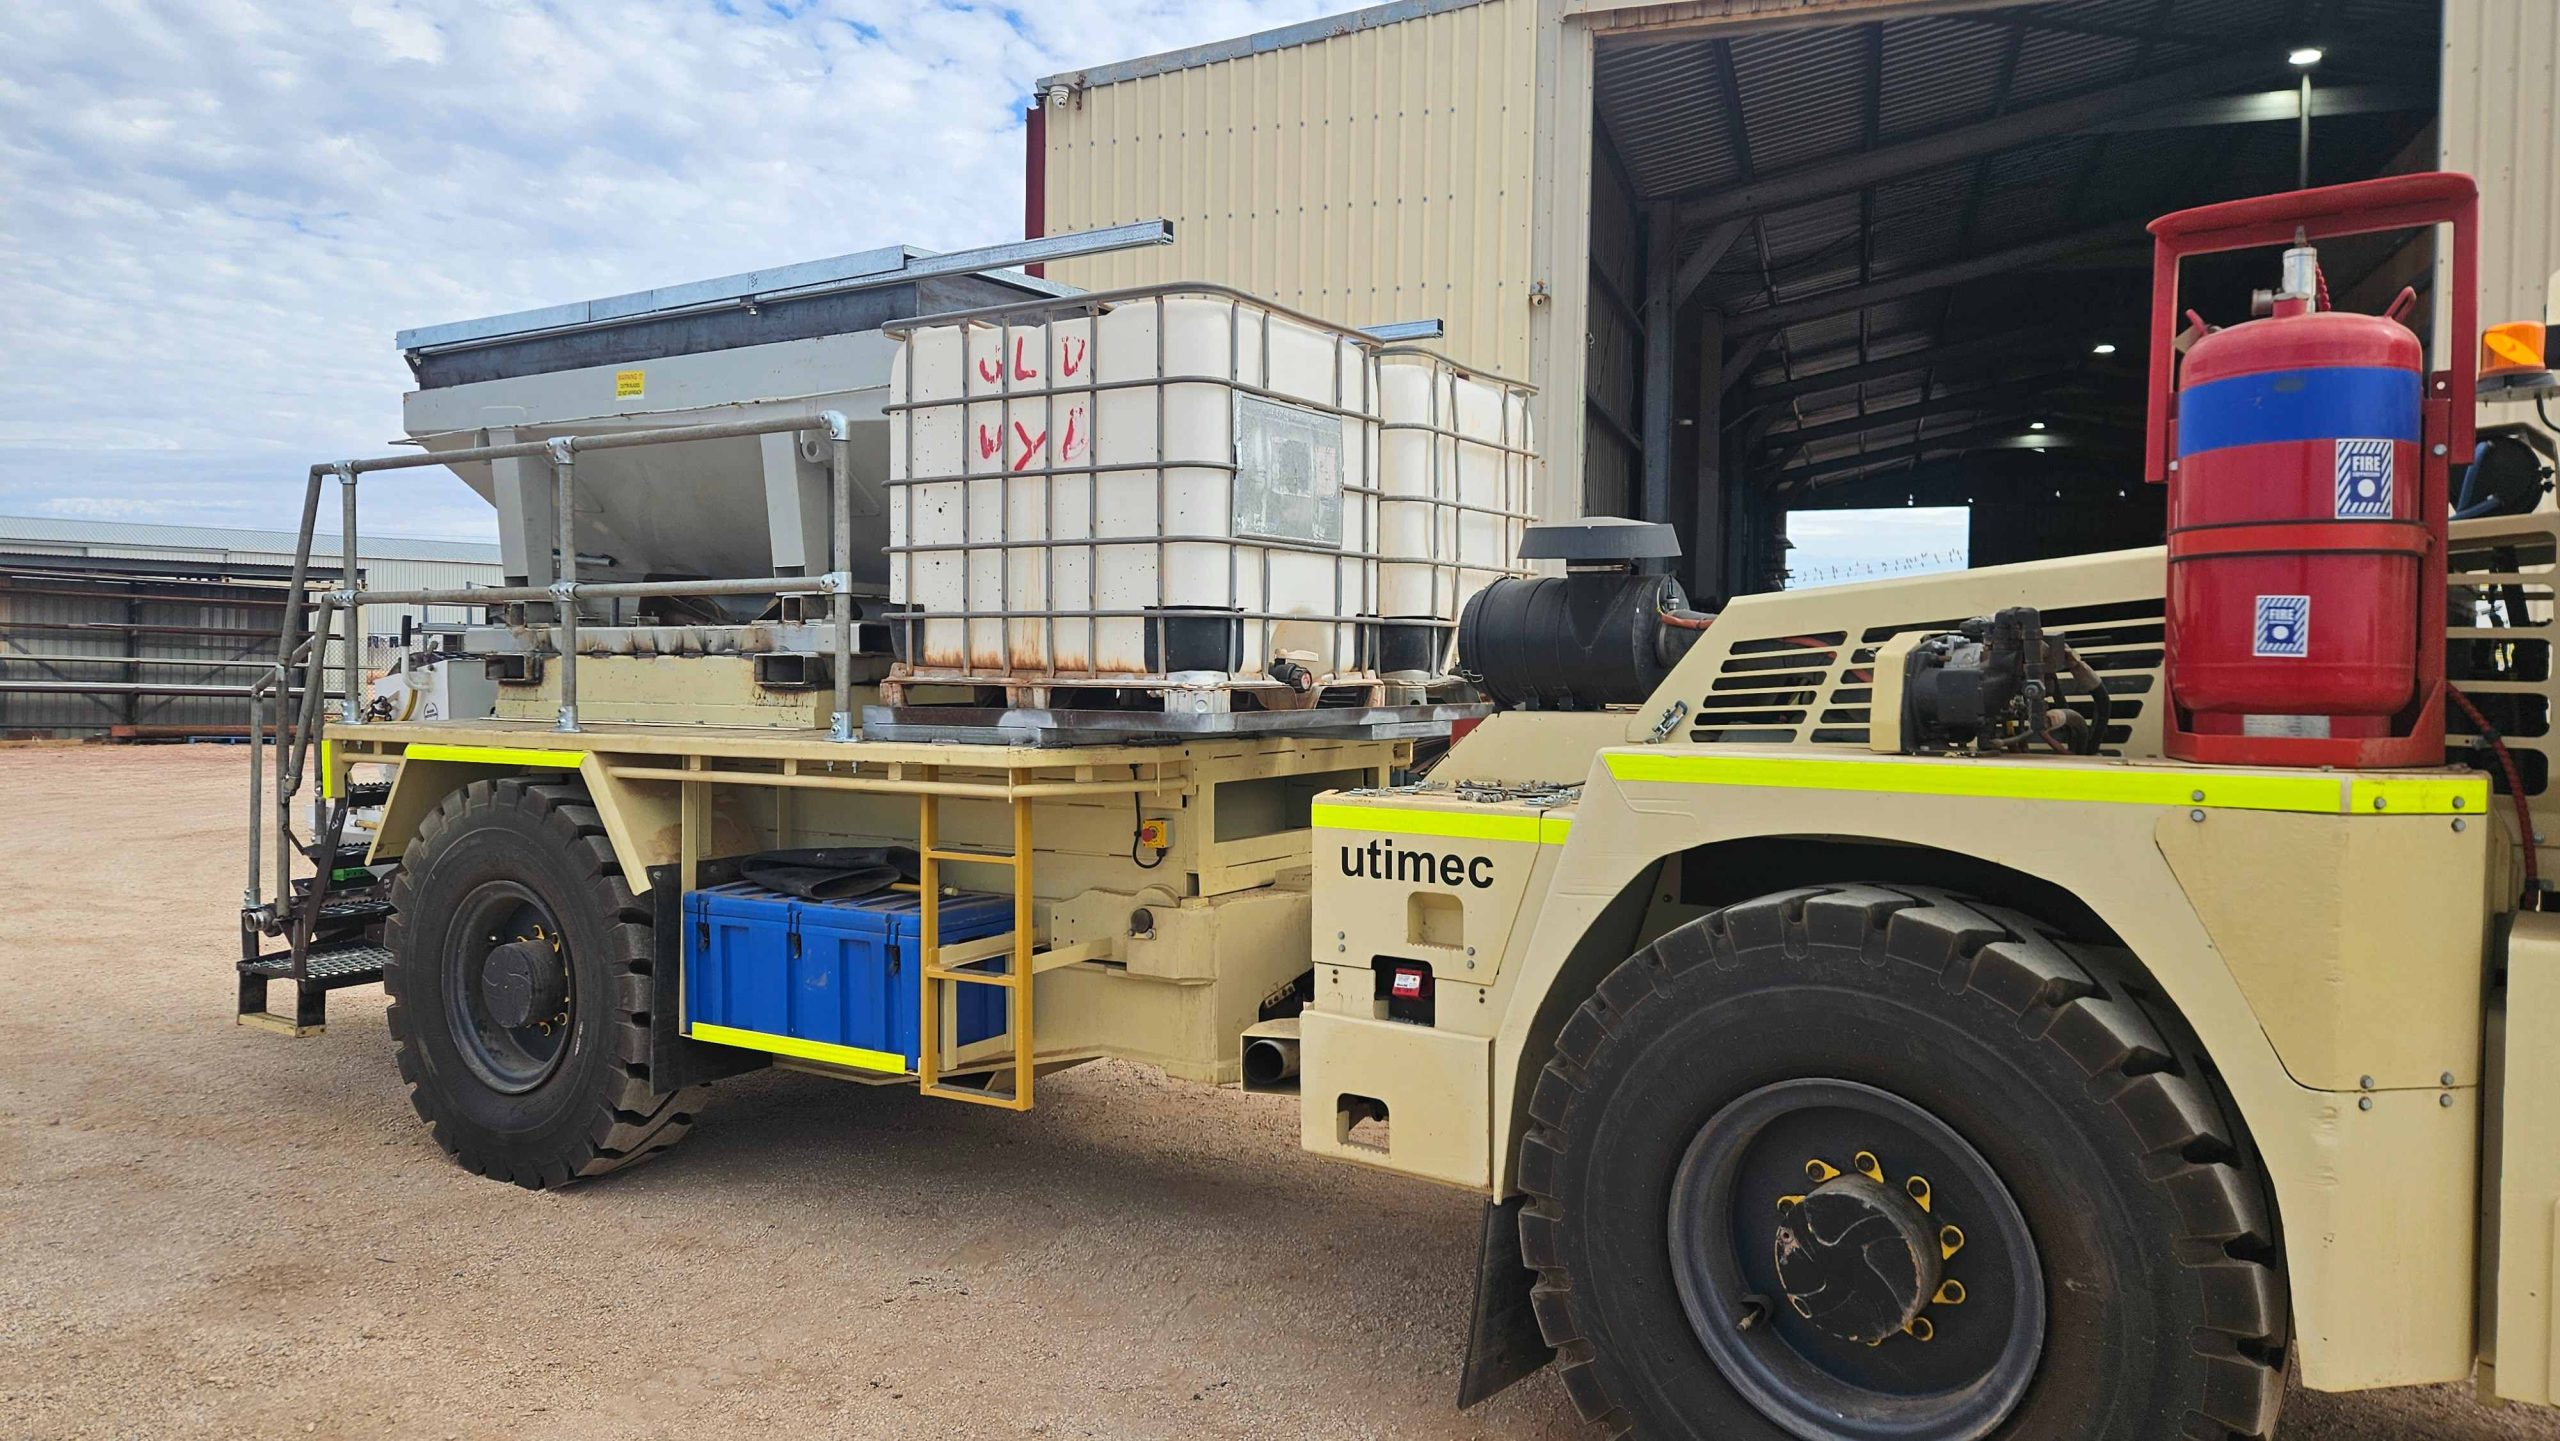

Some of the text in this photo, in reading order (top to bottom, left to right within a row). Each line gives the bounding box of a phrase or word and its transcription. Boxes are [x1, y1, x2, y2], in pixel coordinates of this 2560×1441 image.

[2352, 455, 2381, 472] FIRE
[2269, 608, 2295, 621] FIRE
[1341, 838, 1494, 889] utimec
